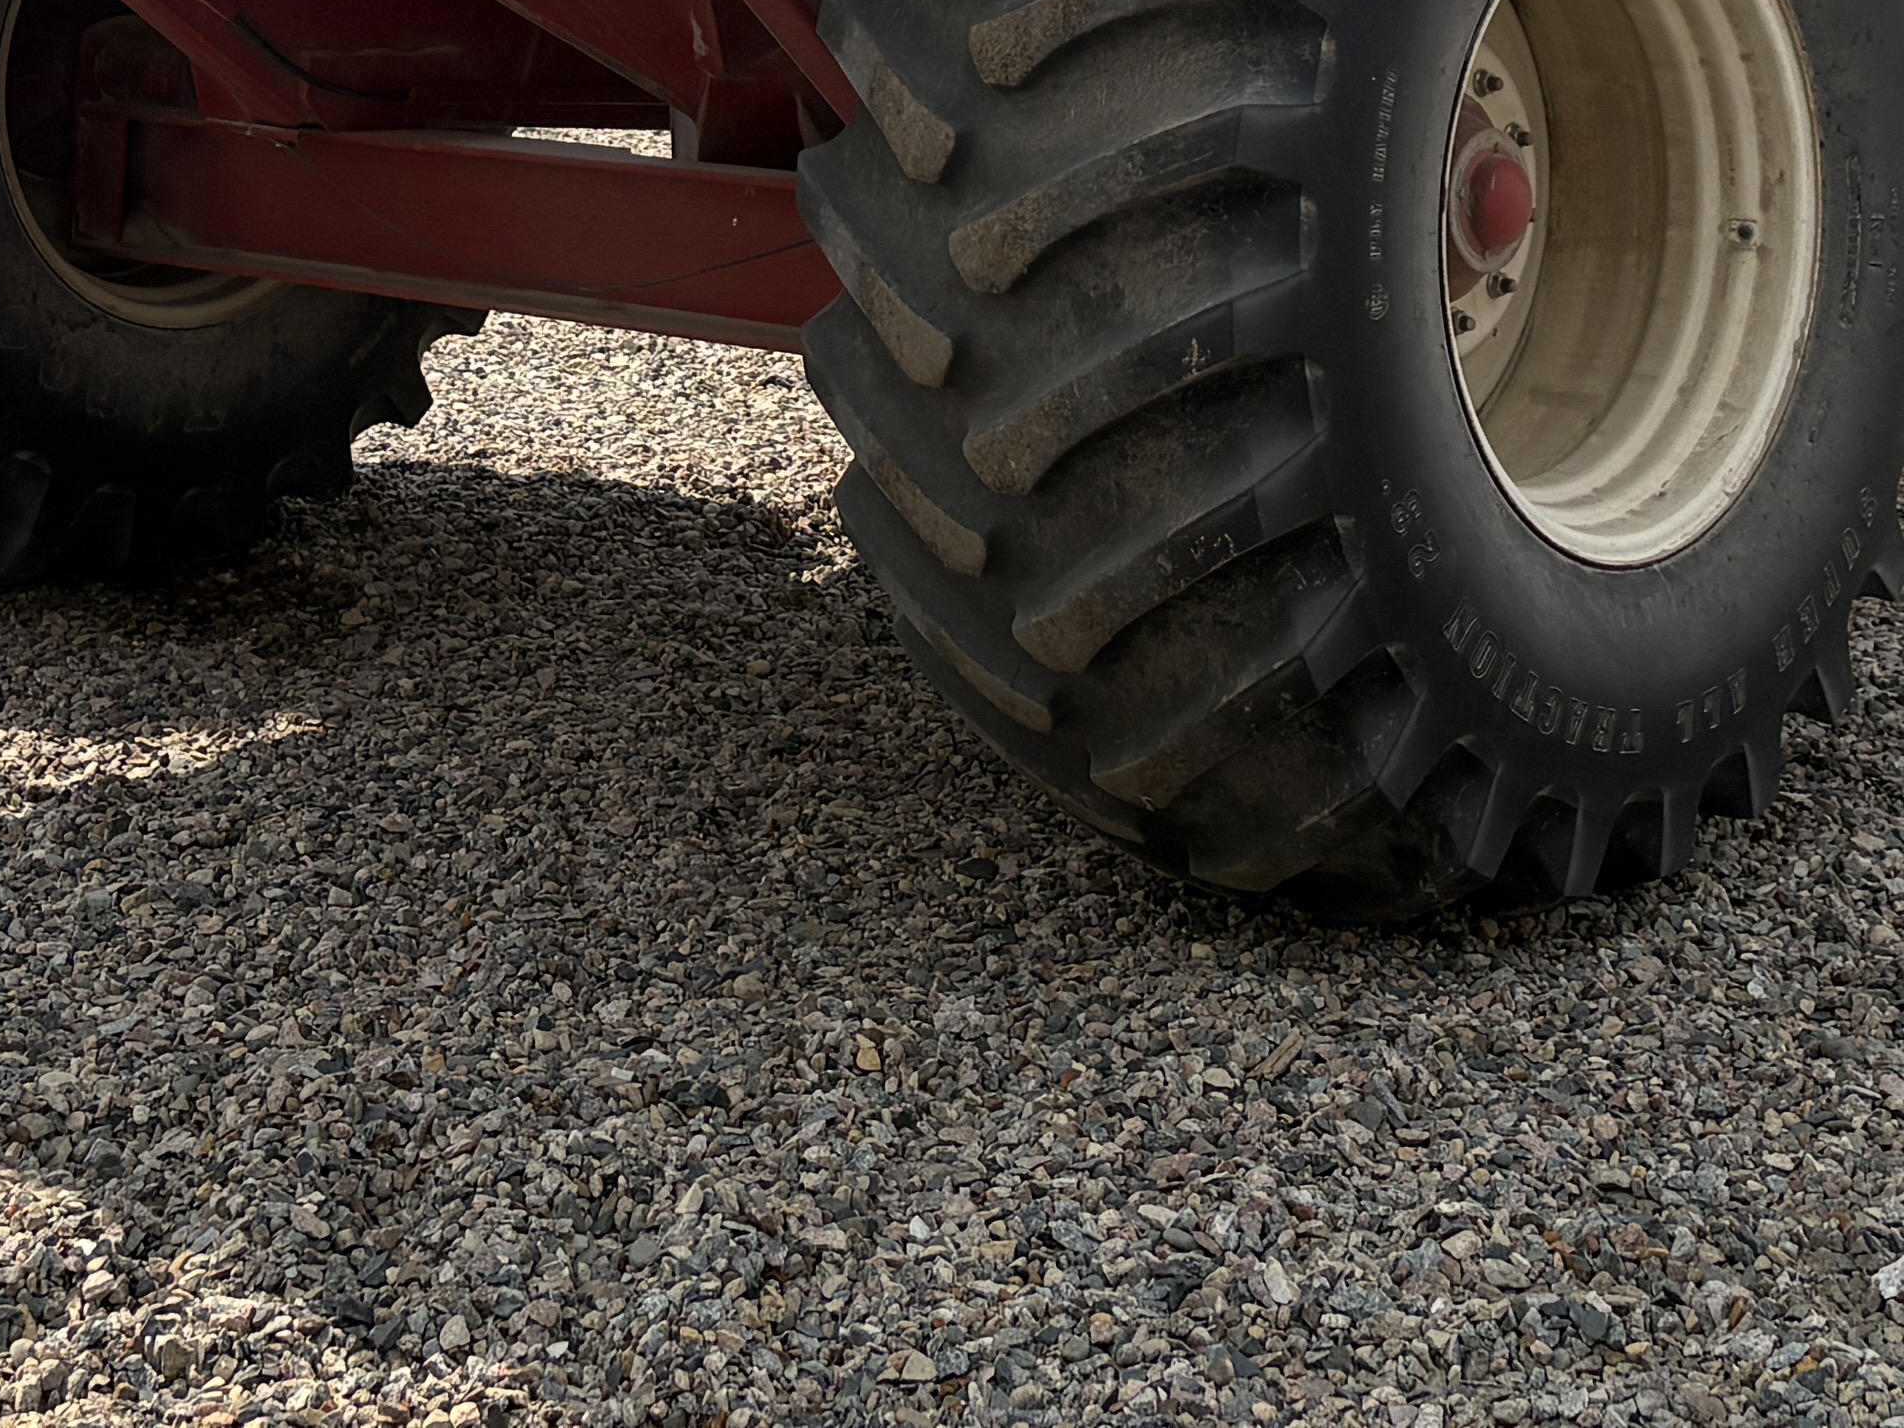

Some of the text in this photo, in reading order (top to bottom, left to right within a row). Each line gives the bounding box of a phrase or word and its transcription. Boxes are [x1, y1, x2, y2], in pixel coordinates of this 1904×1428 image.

[1771, 486, 1878, 673] SUPER
[1440, 596, 1645, 755] TRACTION
[1674, 667, 1748, 745] ALL
